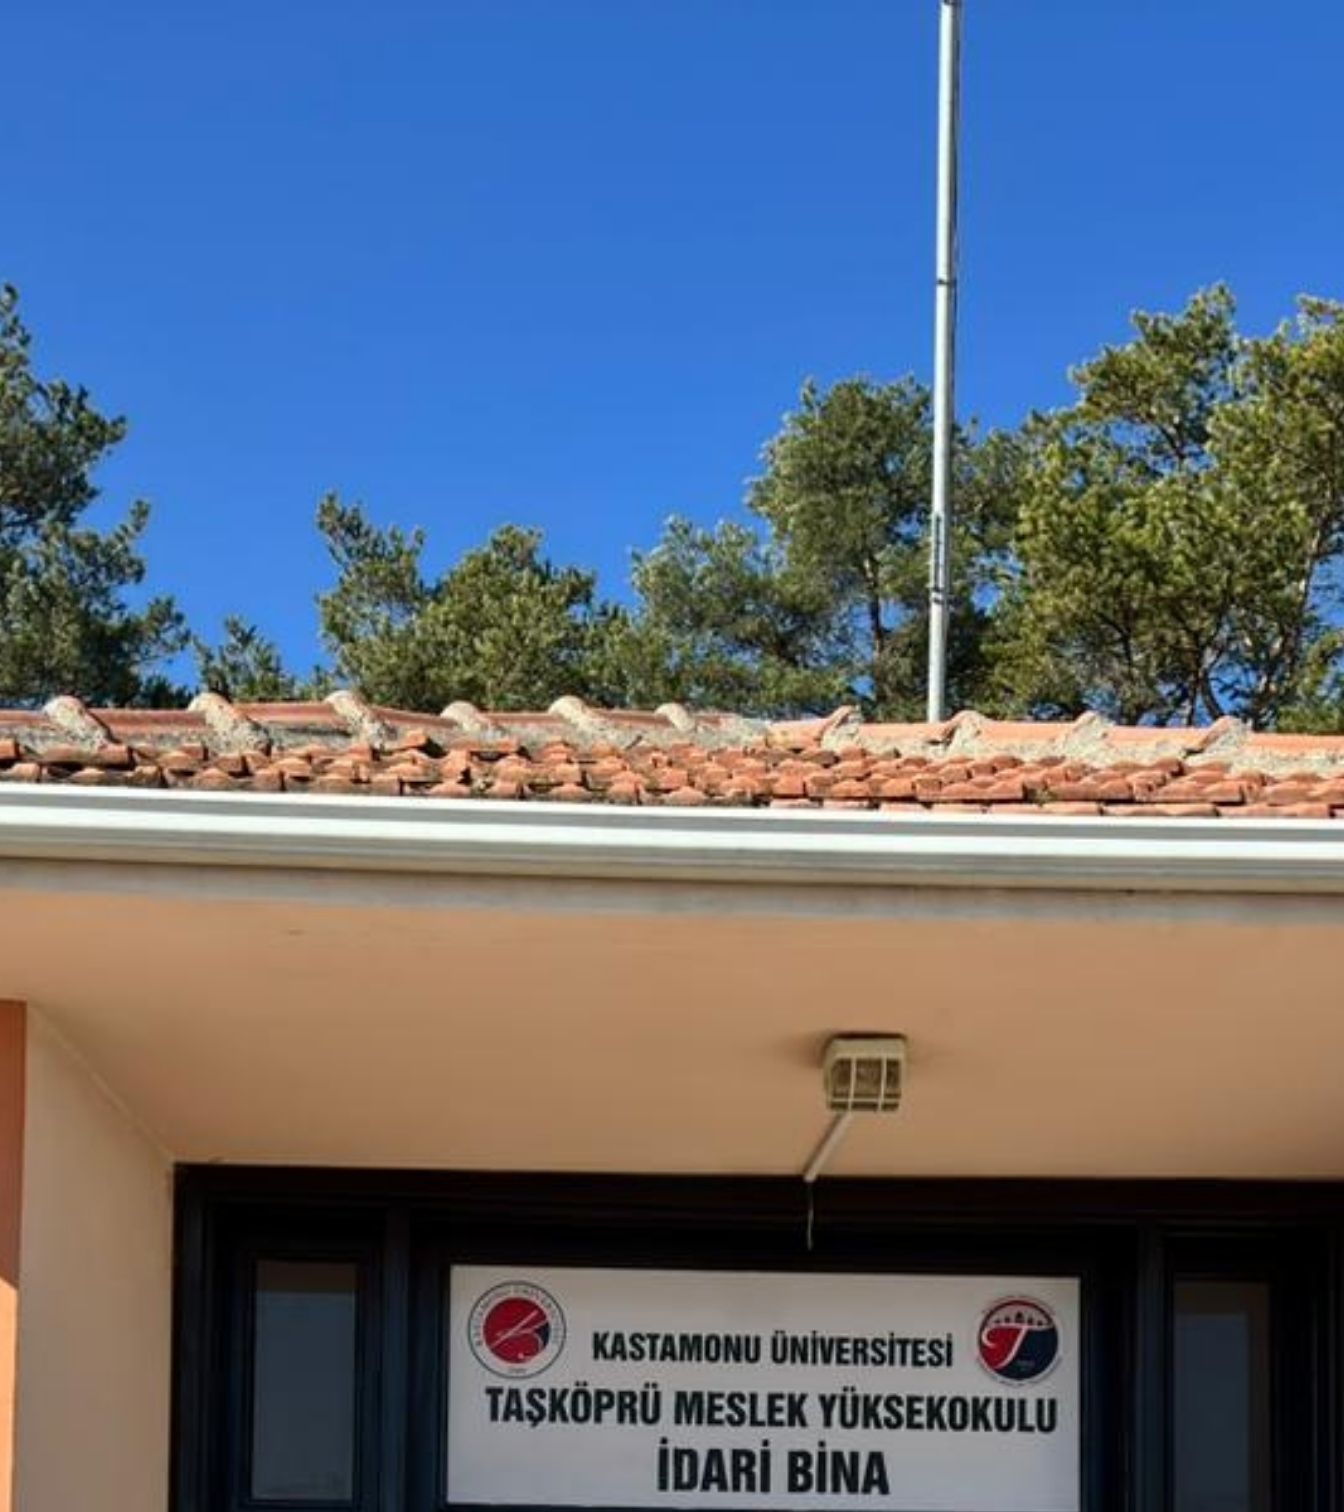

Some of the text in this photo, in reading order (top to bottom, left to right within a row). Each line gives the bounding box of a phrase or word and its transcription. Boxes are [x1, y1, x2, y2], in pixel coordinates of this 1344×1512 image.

[592, 1330, 953, 1367] KASTAMONU ÜNİVERSİTESİ
[485, 1380, 1057, 1433] TAŞKÖPRÜ MESLEK YÜKSEKOKULU
[657, 1437, 890, 1495] İDARİ BİNA
